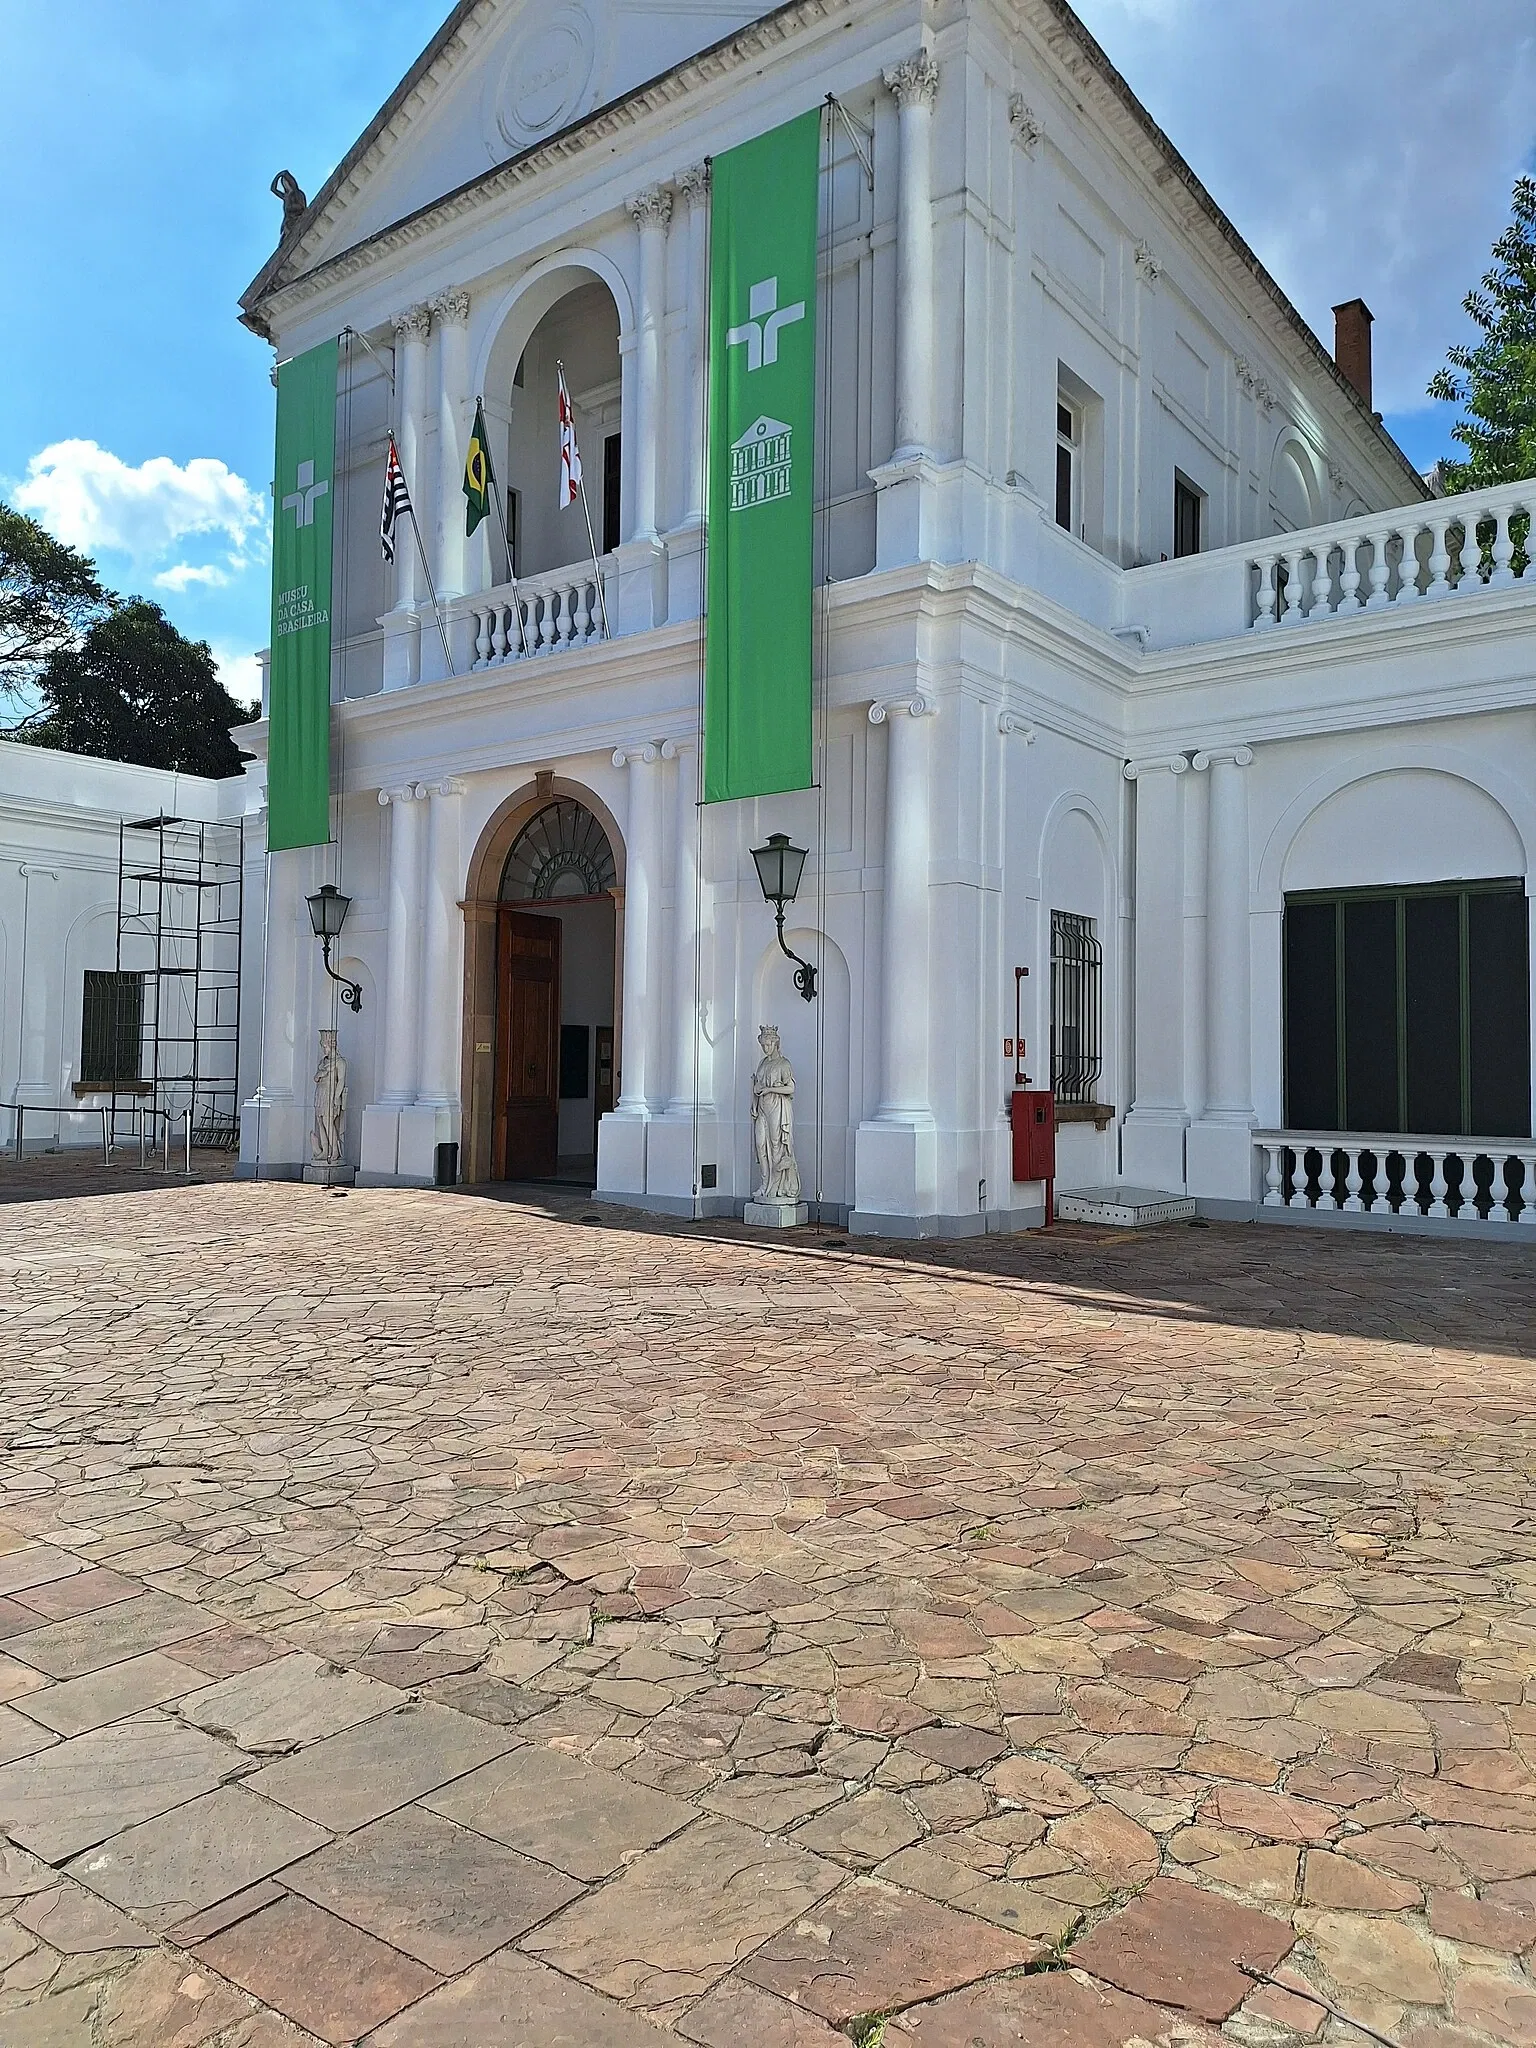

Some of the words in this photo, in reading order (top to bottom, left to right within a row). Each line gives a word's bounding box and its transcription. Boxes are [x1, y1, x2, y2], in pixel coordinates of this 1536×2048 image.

[279, 585, 308, 606] MUSEU
[278, 607, 289, 621] DA
[290, 599, 314, 617] CASA
[277, 610, 329, 636] BRASILEIRA
